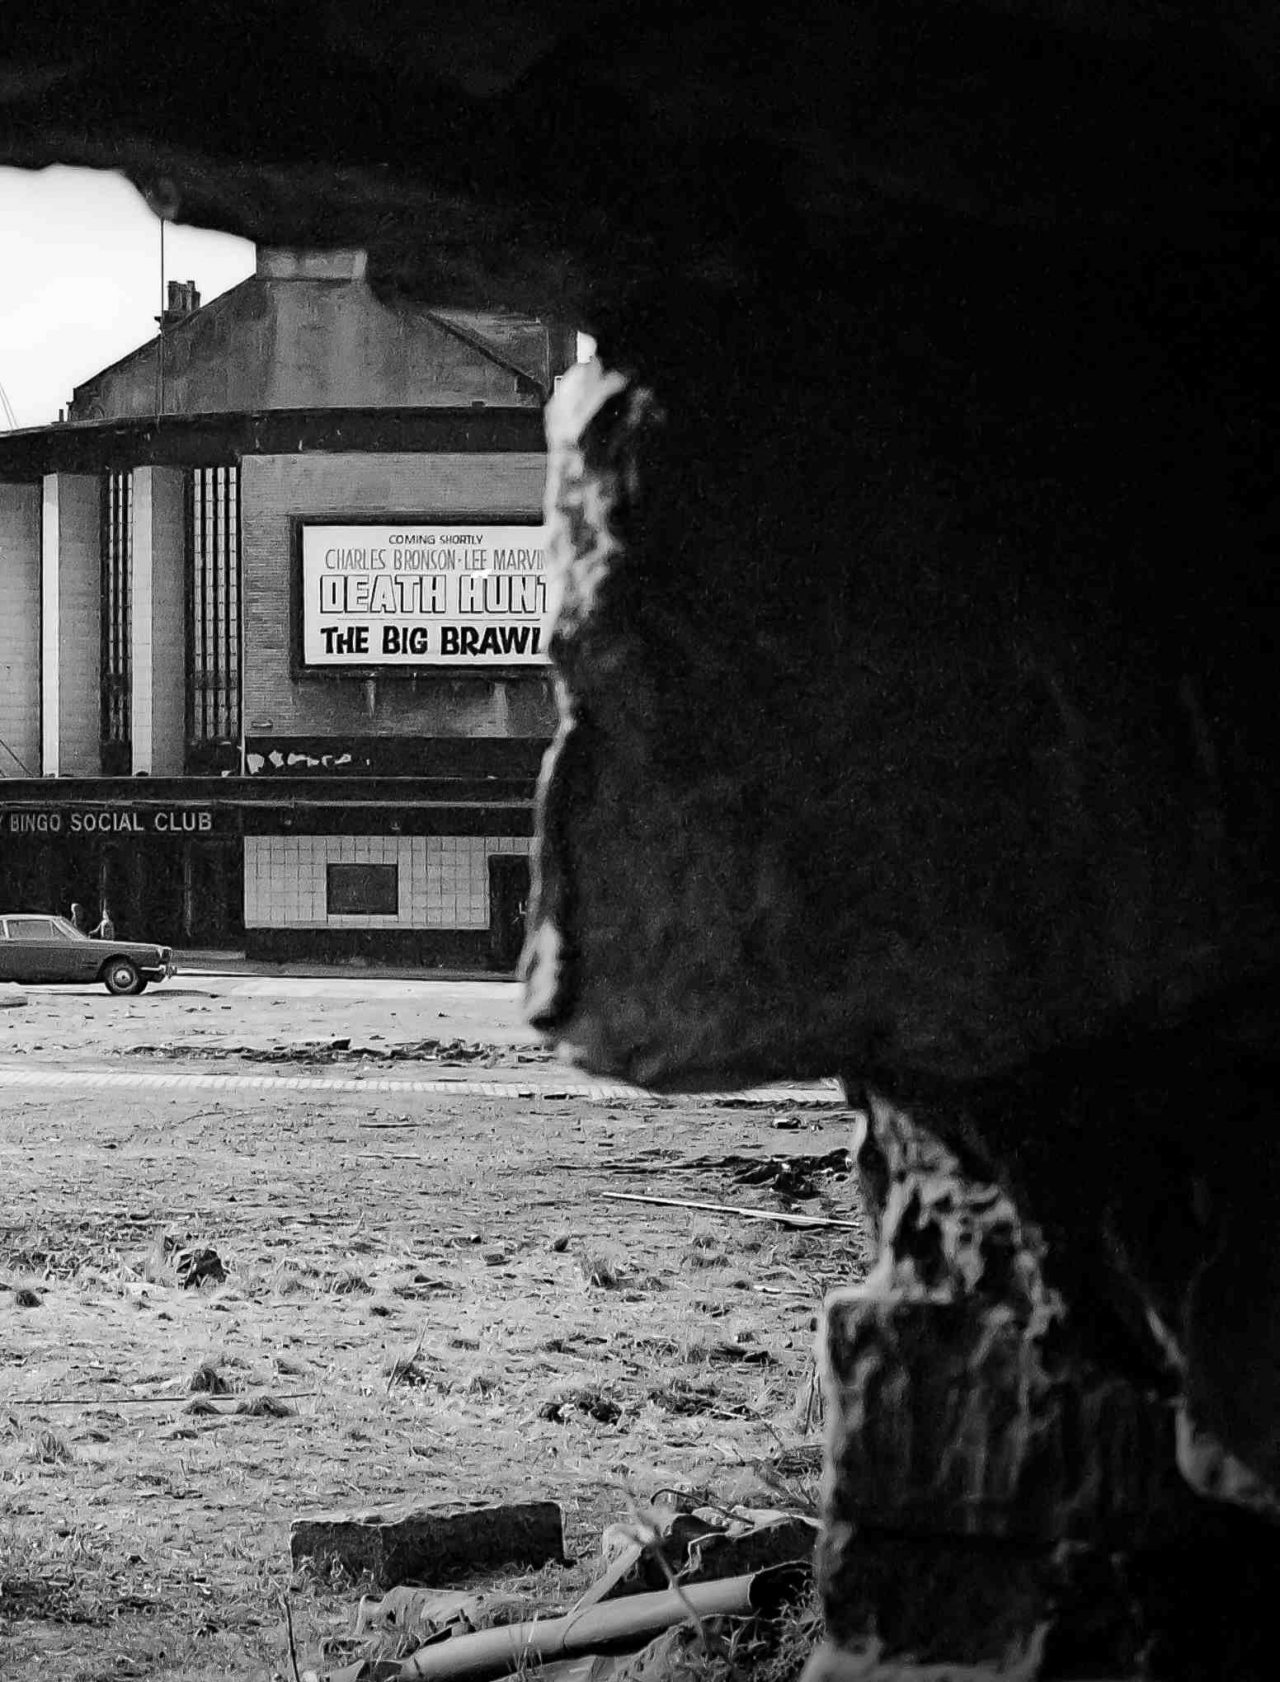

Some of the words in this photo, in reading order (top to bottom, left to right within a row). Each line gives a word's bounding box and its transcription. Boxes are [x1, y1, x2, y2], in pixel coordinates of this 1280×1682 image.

[388, 534, 435, 545] COMING
[439, 534, 483, 545] SHORTLY
[325, 549, 385, 570] CHARLES
[393, 549, 455, 570] BRONSON
[464, 549, 487, 570] LEE
[320, 574, 446, 613] DEATH
[321, 626, 369, 654] THE
[382, 625, 428, 654] BIG
[10, 813, 61, 832] BINGO
[70, 812, 144, 831] SOCIAL
[154, 812, 212, 831] CLUB
